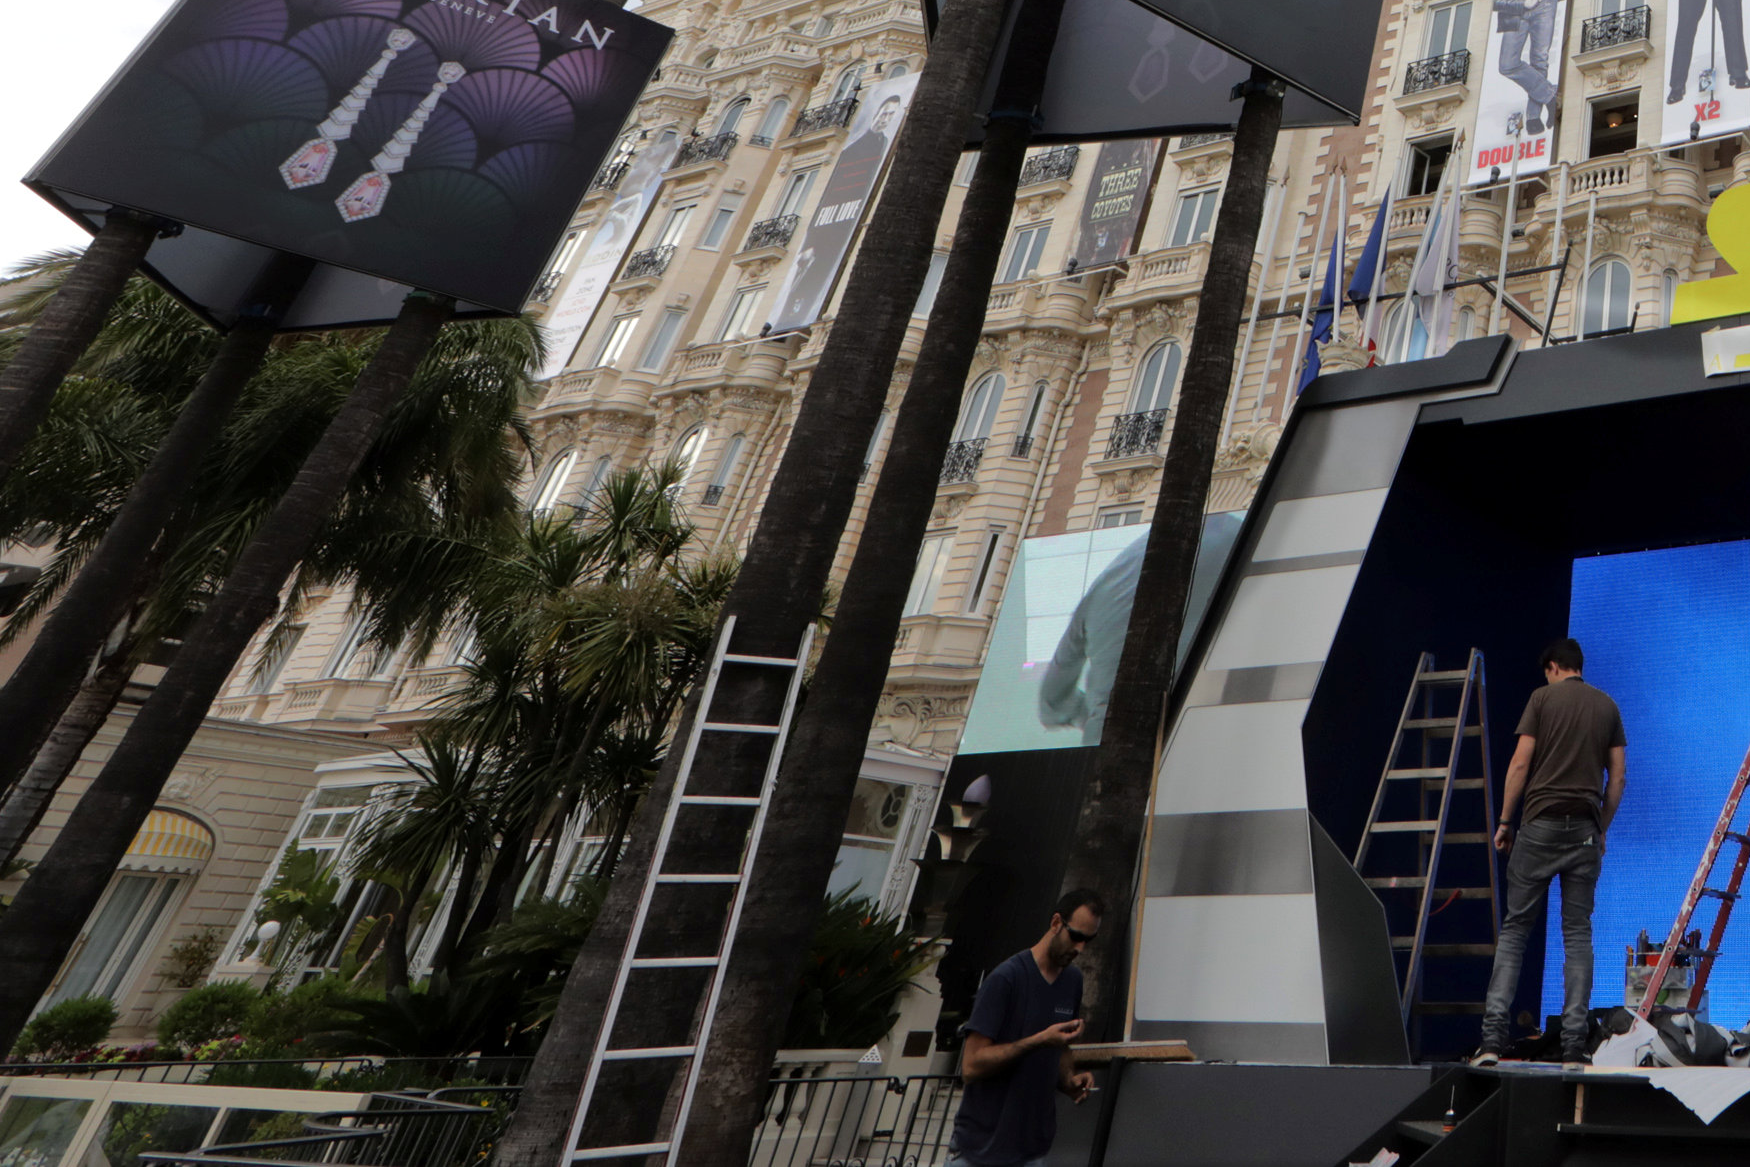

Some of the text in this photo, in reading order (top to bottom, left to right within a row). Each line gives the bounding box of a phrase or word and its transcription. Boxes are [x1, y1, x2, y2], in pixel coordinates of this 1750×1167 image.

[1694, 100, 1721, 121] X2
[1099, 168, 1143, 198] THREE
[814, 199, 863, 227] FULL LOVE
[1090, 194, 1135, 220] COYOTES
[1706, 353, 1723, 374] A
